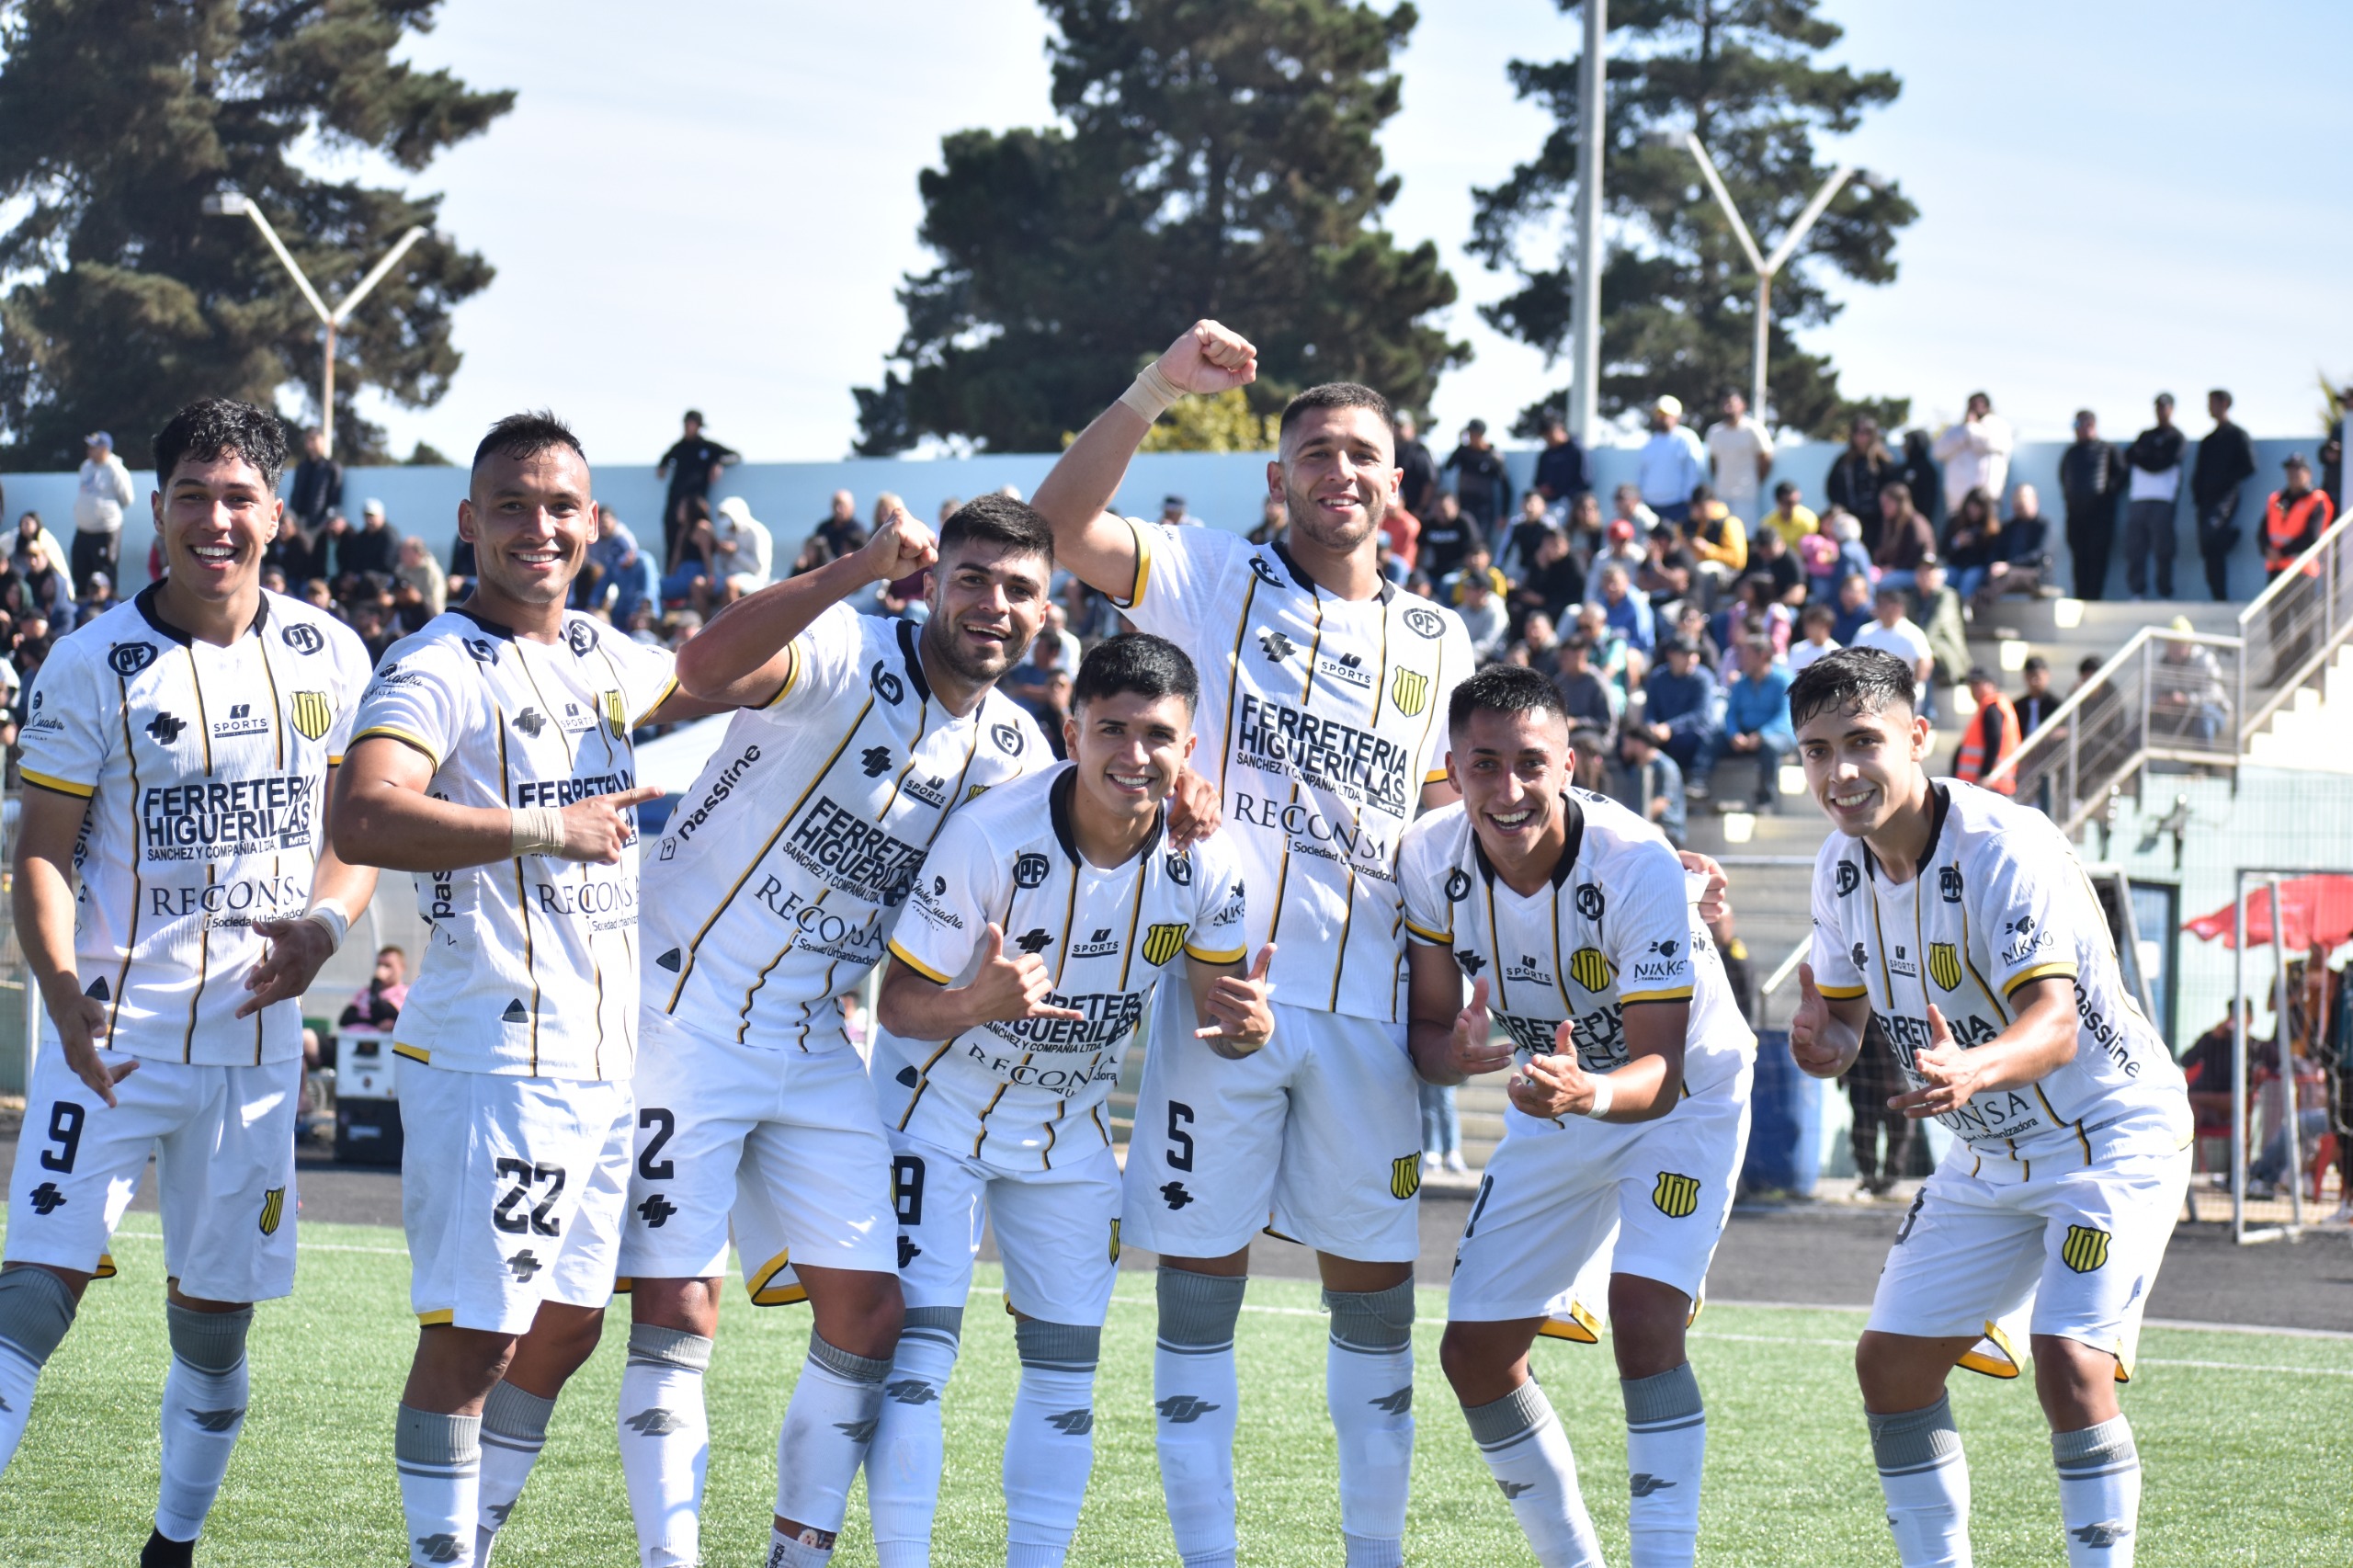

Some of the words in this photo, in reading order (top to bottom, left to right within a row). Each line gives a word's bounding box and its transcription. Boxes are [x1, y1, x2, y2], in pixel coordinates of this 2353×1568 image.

[1412, 613, 1435, 634] PF
[292, 628, 313, 650] PF
[119, 647, 144, 670] PF
[1321, 661, 1371, 684] SPORTS
[213, 718, 267, 733] SPORTS
[560, 716, 594, 728] SPORTS
[1241, 693, 1407, 779] FERRETERIA
[1238, 722, 1406, 805] HIGUERILLAS
[1236, 752, 1282, 775] SANCHEZ
[1283, 764, 1290, 777] Y
[1338, 785, 1363, 802] LTDA.
[906, 779, 947, 804] SPORTS
[147, 846, 194, 861] SANCHEZ
[196, 846, 203, 859] Y
[205, 841, 257, 859] COMPAÑIA
[288, 834, 311, 846] MTS
[1293, 841, 1338, 862] Sociedad
[782, 842, 826, 879] SANCHEZ
[823, 869, 832, 883] Y
[1020, 859, 1045, 883] PF
[1073, 940, 1120, 953] SPORTS
[2001, 930, 2054, 968] NIKKO
[1506, 966, 1552, 983] SPORTS
[1890, 959, 1915, 972] SPORTS
[1020, 1040, 1030, 1051] Y
[1029, 1041, 1078, 1053] COMPAÑIA
[40, 1100, 85, 1175] 9
[638, 1108, 676, 1180] 2
[1166, 1099, 1194, 1173] 5
[493, 1157, 566, 1237] 22
